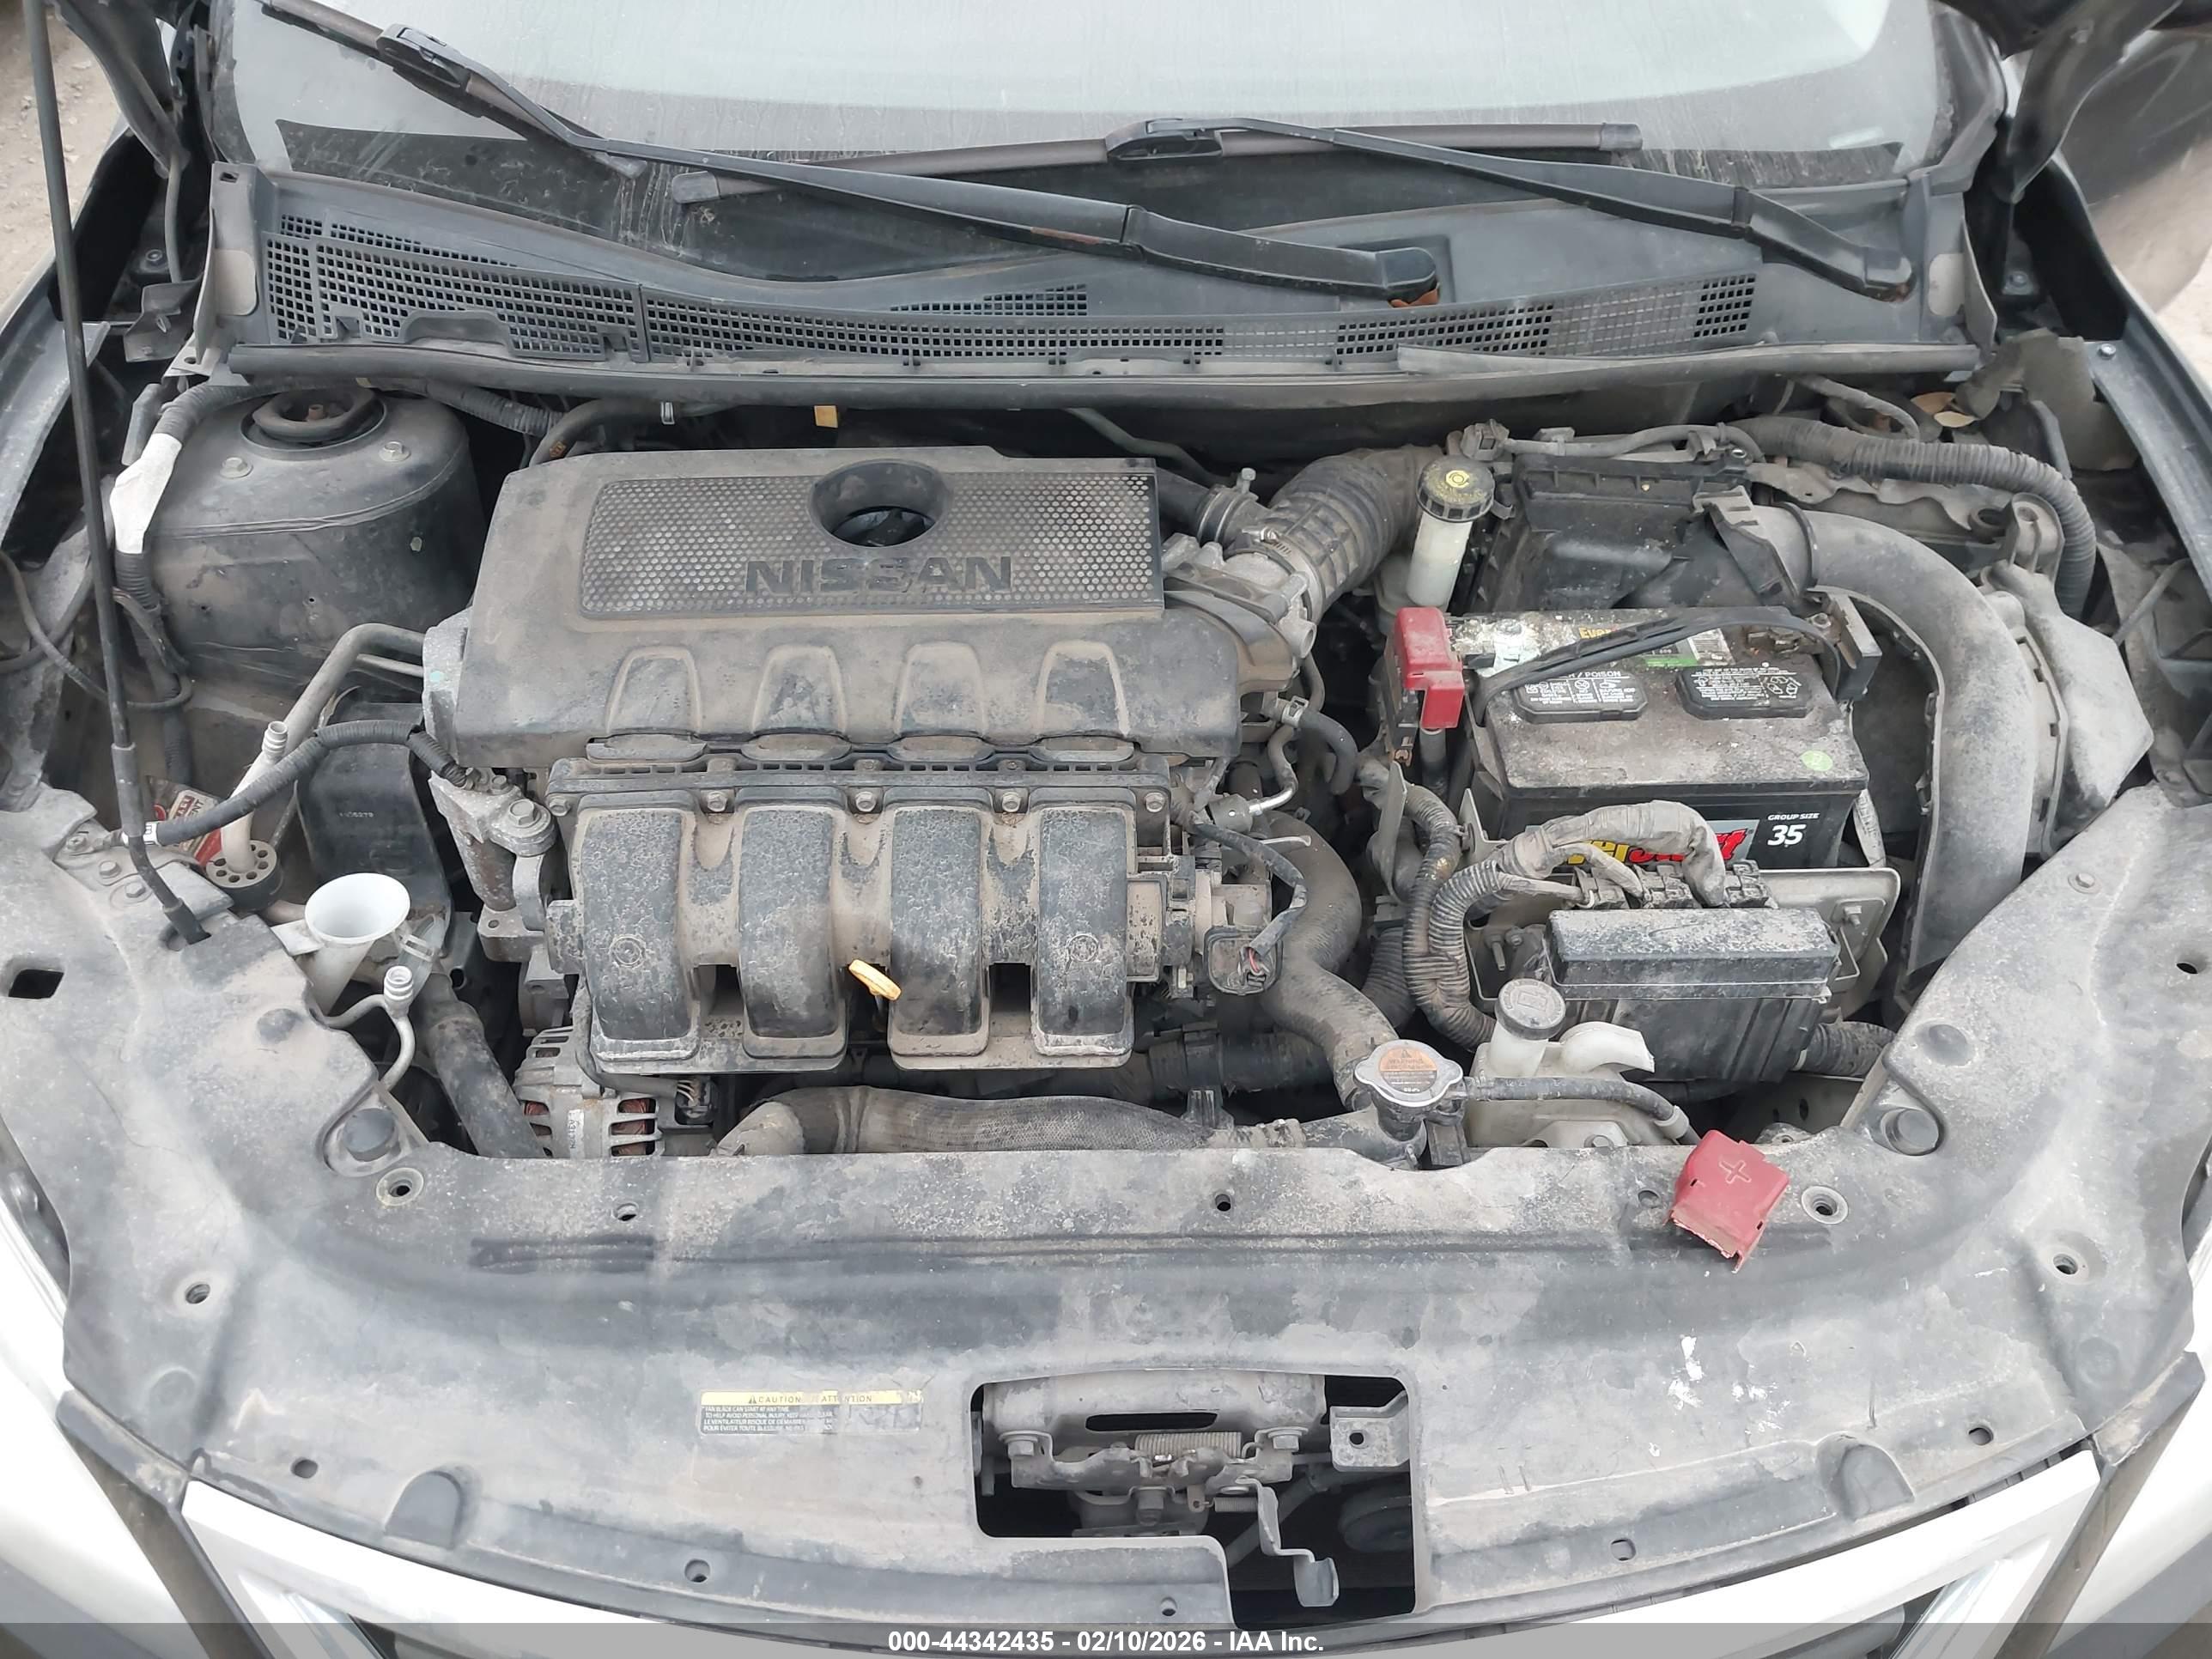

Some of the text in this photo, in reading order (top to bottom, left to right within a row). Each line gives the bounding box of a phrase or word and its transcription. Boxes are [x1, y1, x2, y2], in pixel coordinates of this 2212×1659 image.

[746, 556, 1012, 592] NISSAN
[1767, 823, 1807, 846] 35
[822, 1395, 872, 1403] ATTNTION
